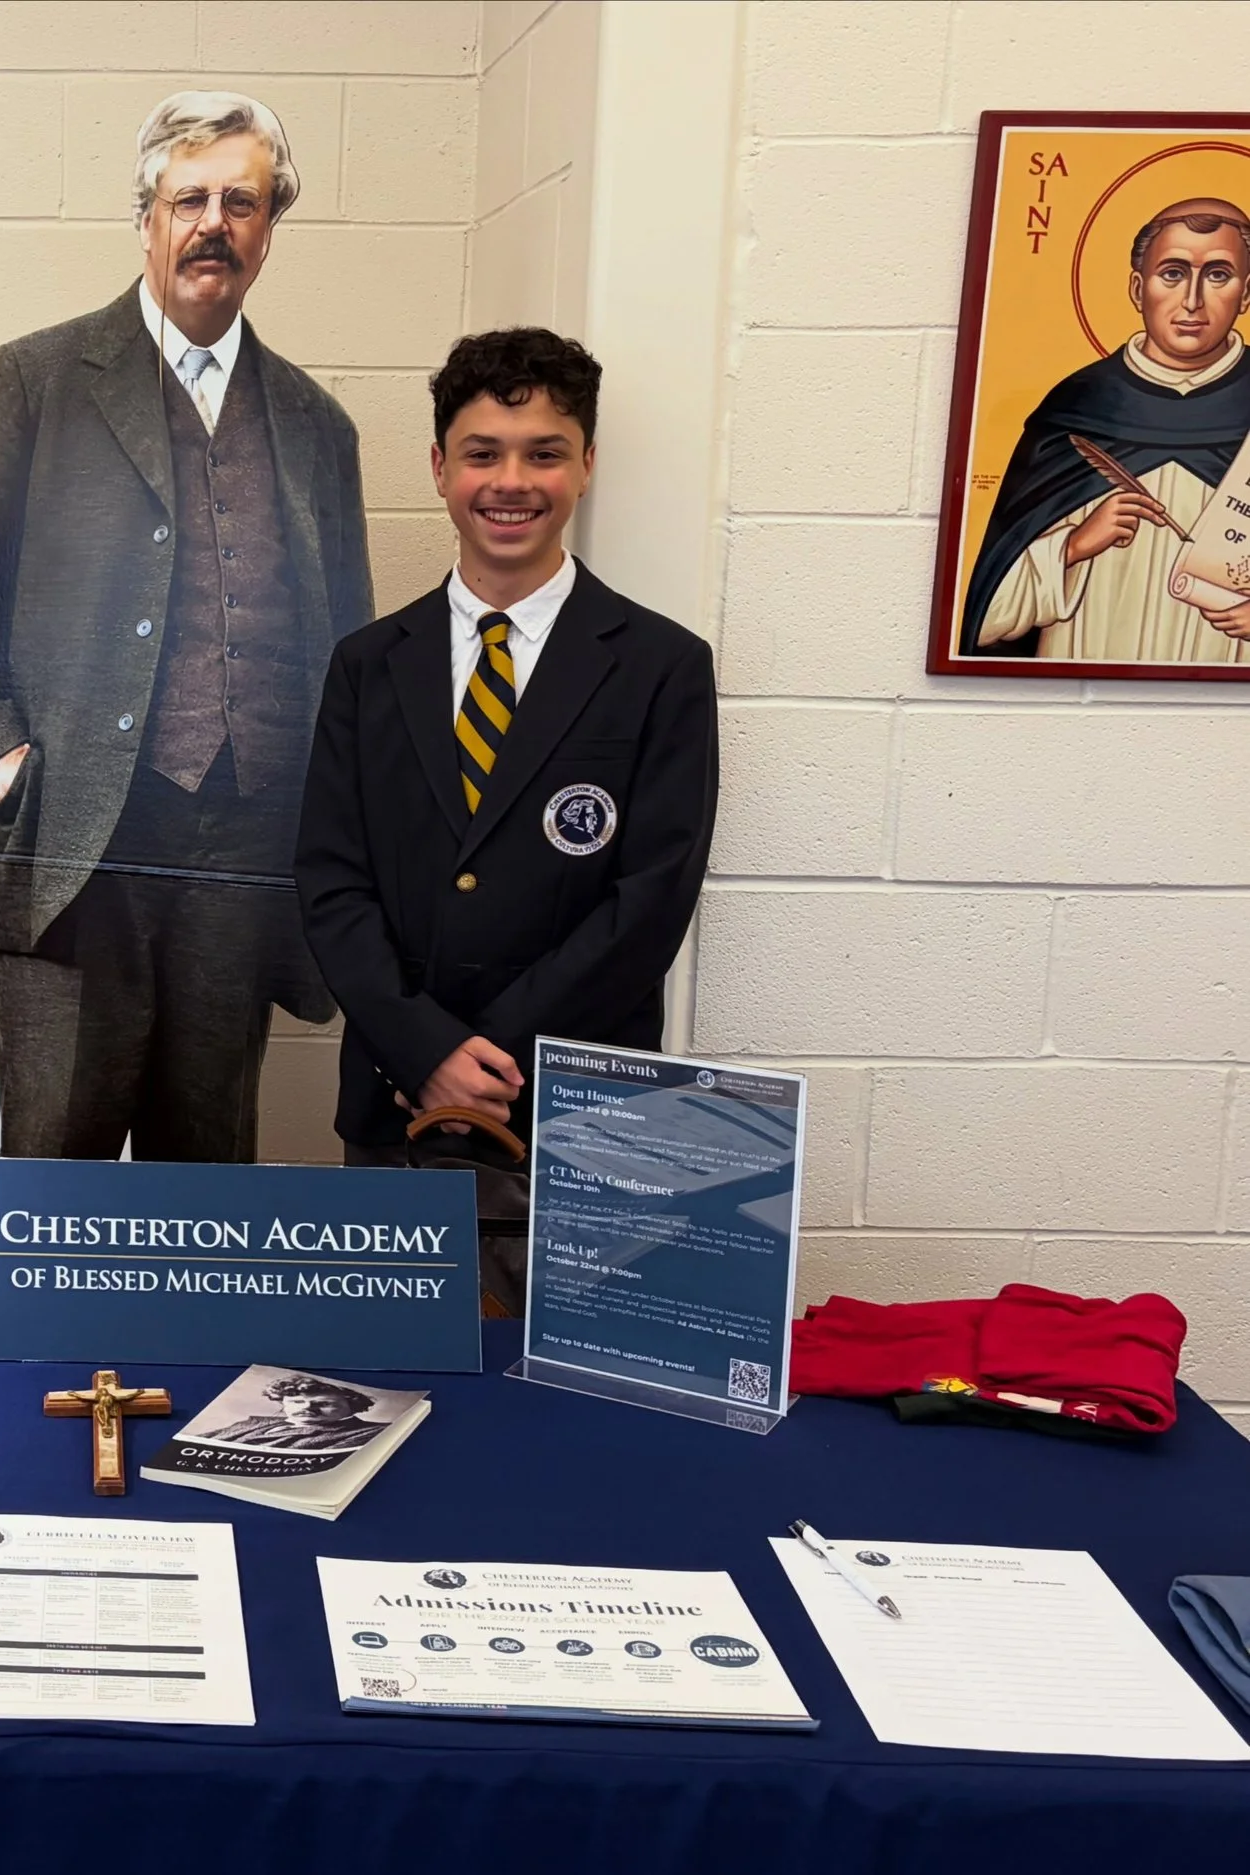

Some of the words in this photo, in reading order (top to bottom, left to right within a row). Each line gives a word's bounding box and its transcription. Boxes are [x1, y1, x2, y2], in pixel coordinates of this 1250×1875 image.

[1225, 528, 1247, 544] OF
[539, 1049, 607, 1073] pcoming
[611, 1059, 658, 1079] Events
[552, 1084, 585, 1101] Open
[587, 1090, 625, 1106] House
[551, 1100, 583, 1112] October
[586, 1104, 599, 1114] 3rd
[601, 1107, 610, 1117] @
[611, 1109, 645, 1122] 10:00am
[550, 1164, 568, 1178] CT
[570, 1167, 604, 1184] Men's
[607, 1174, 675, 1197] Conference
[550, 1178, 581, 1192] October
[583, 1184, 600, 1194] 10th
[0, 1210, 251, 1249] CHESTERTON
[261, 1217, 449, 1254] ACADEMY
[547, 1238, 576, 1254] Look
[578, 1243, 598, 1259] Up!
[546, 1254, 578, 1267] October
[580, 1260, 600, 1272] 22nd
[601, 1265, 610, 1275] @
[611, 1267, 642, 1280] 7:00pm
[10, 1267, 46, 1289] OF
[53, 1265, 159, 1292] BLESSED
[166, 1268, 289, 1297] MICHAEL
[542, 1333, 559, 1345] Stay
[561, 1337, 571, 1347] up
[573, 1339, 581, 1347] to
[583, 1341, 601, 1352] date
[603, 1346, 621, 1356] with
[623, 1350, 664, 1367] upcoming
[665, 1360, 695, 1373] events!
[180, 1447, 334, 1466] ORTHODOXY
[214, 1464, 315, 1473] CHESTERTON
[373, 1595, 554, 1614] Admissions
[560, 1600, 703, 1616] Timeline
[553, 1616, 619, 1625] SCHOOL
[694, 1646, 757, 1658] CABMM
